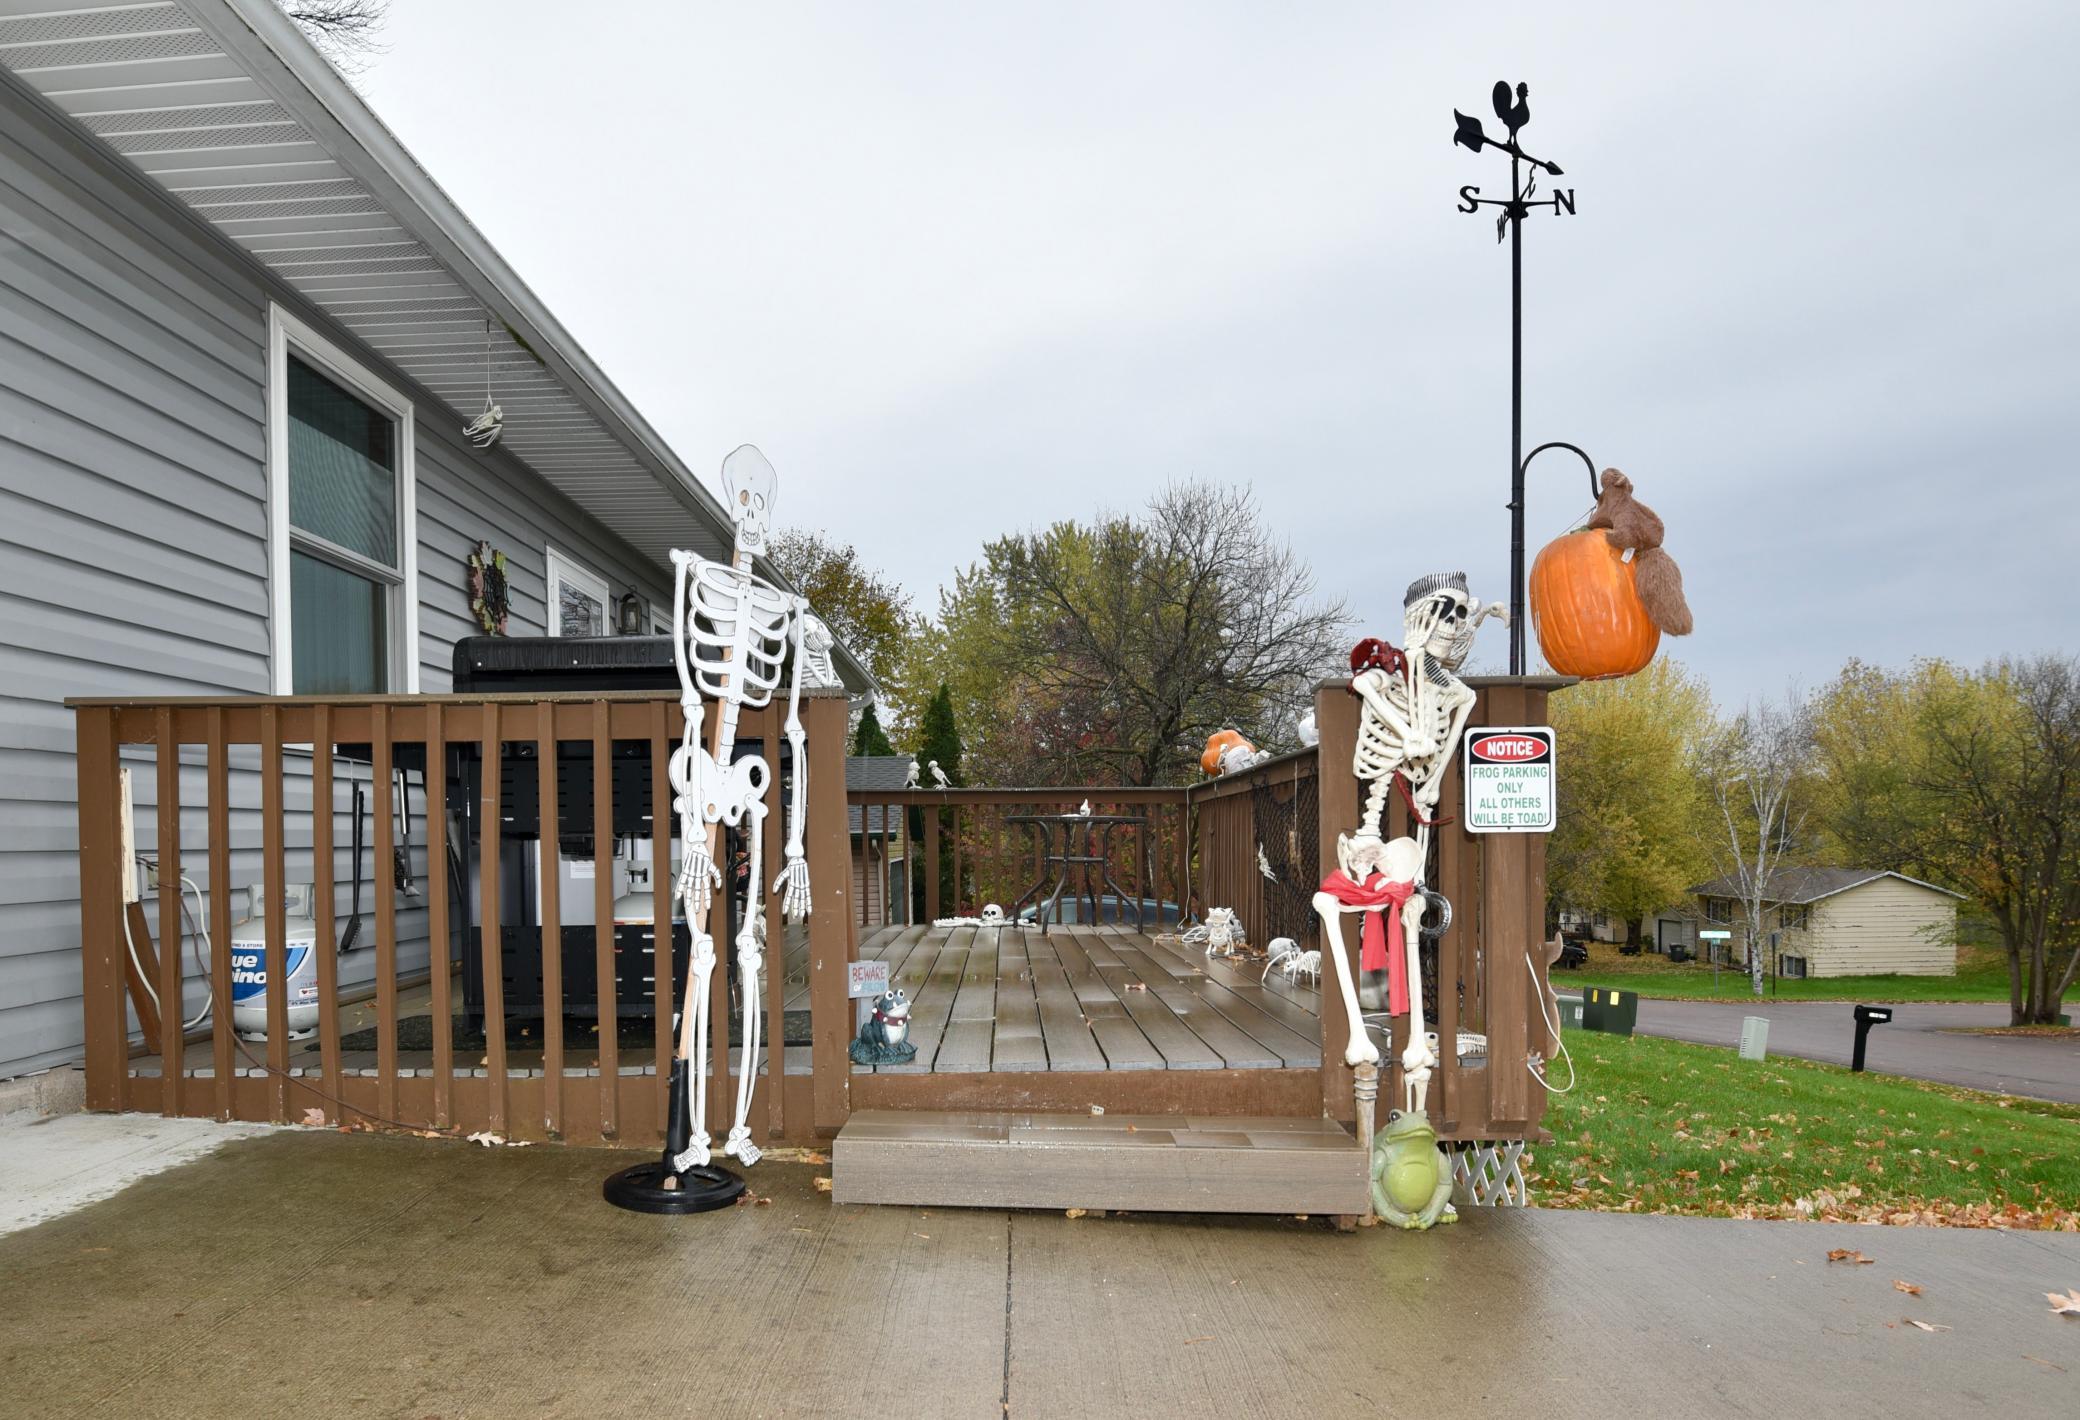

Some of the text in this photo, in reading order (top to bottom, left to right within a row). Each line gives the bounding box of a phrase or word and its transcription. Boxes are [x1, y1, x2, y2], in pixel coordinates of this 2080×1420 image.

[1457, 185, 1480, 214] S
[1553, 189, 1576, 216] N
[1487, 740, 1534, 756] NOTICE
[1473, 766, 1547, 778] FROG PARKING
[1497, 782, 1523, 793] ONLY
[1480, 797, 1541, 809] ALL OTHERS
[1474, 812, 1547, 824] WILL BE TOAD!
[232, 955, 258, 968] ue
[232, 968, 267, 984] ino
[852, 966, 886, 982] BEWARE
